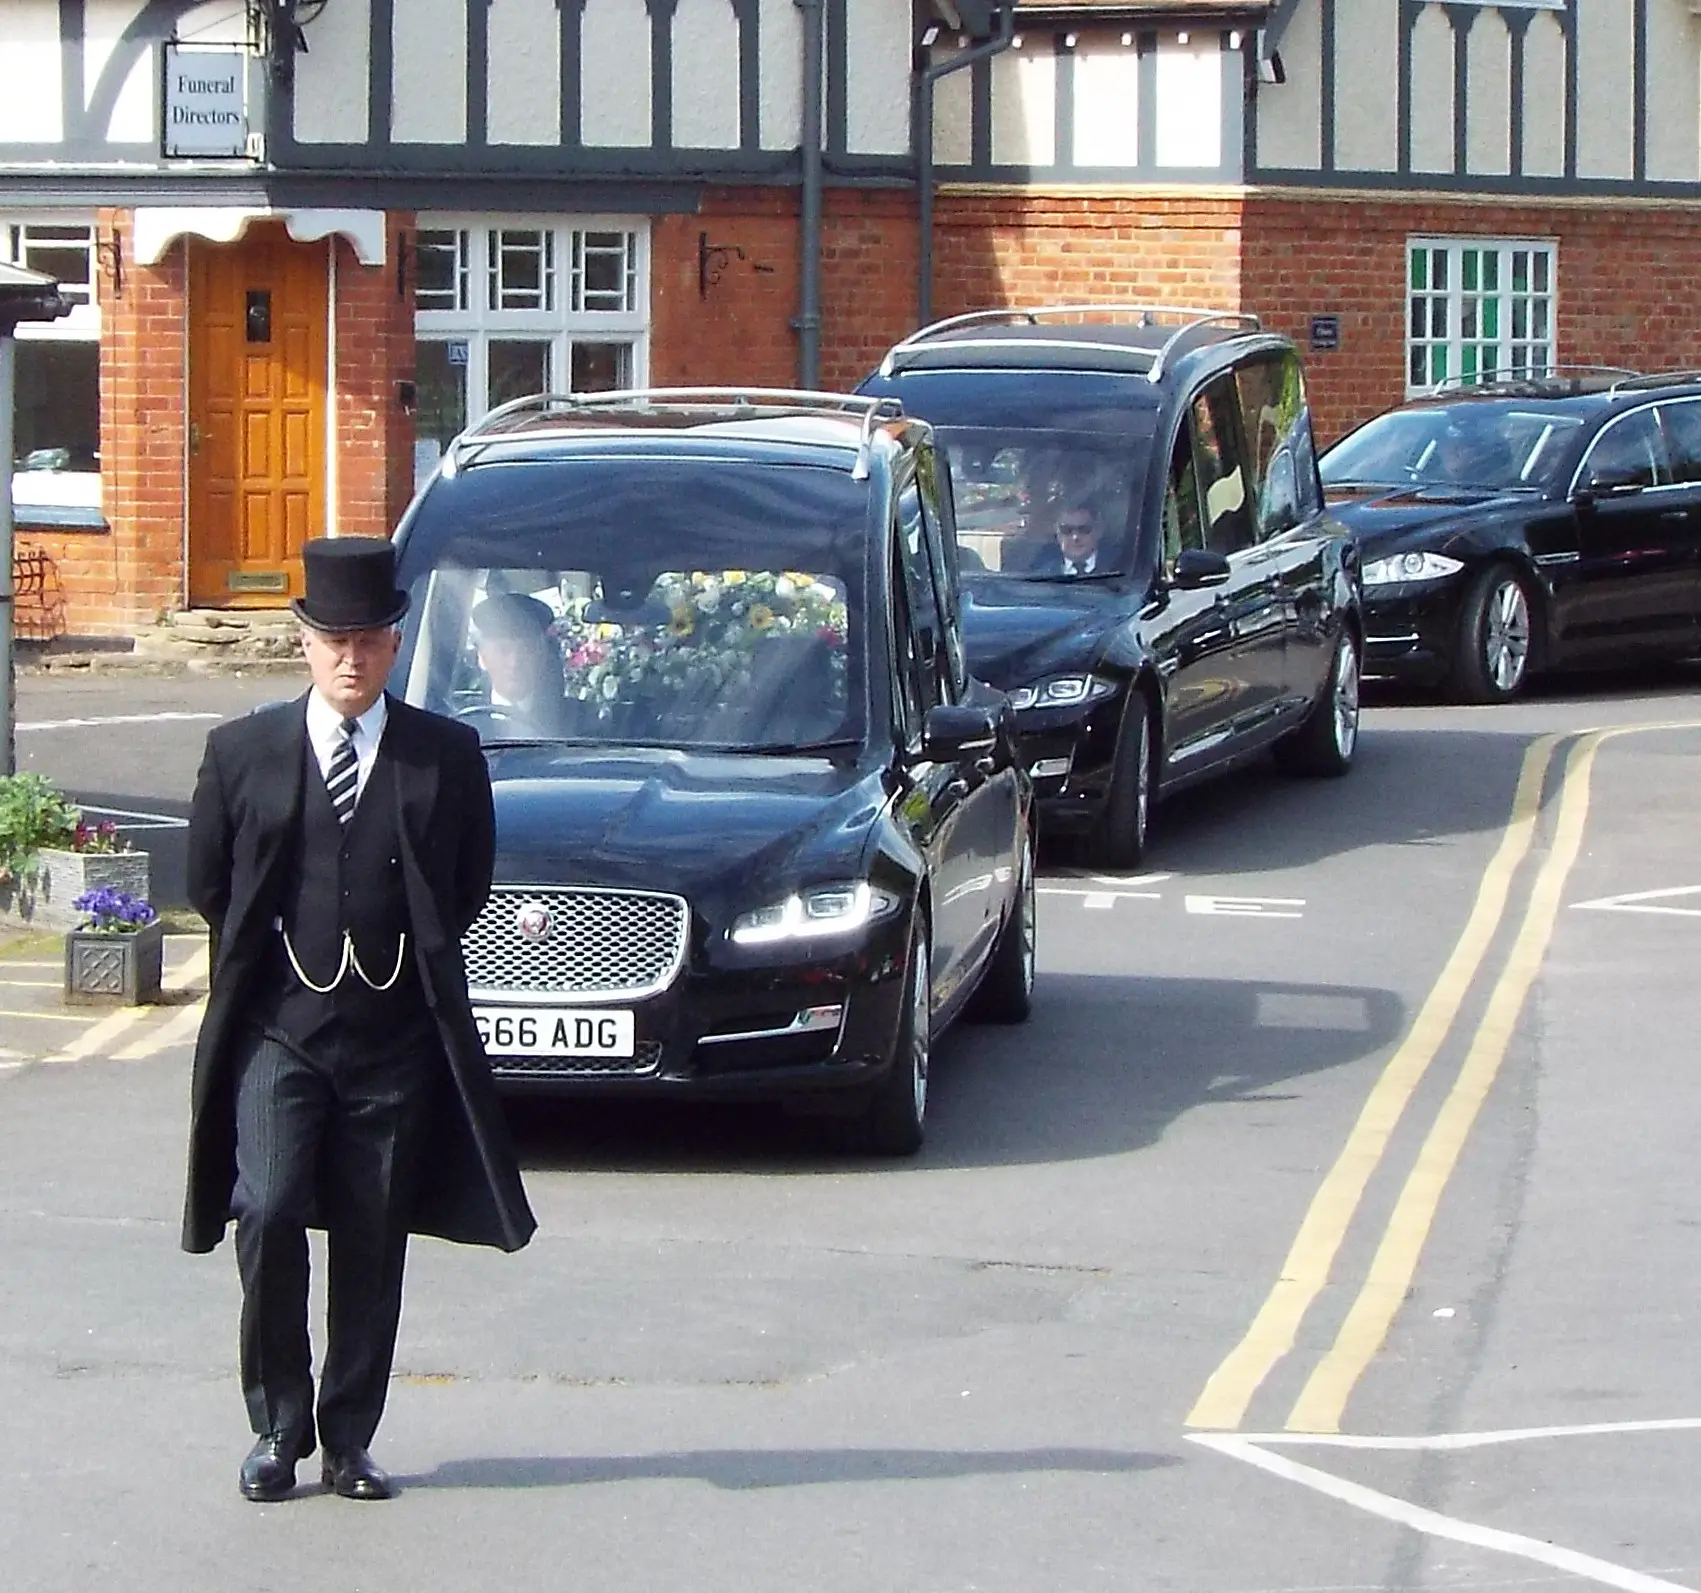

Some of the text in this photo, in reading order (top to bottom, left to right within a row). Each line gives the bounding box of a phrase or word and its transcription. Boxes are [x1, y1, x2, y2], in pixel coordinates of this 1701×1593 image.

[178, 75, 234, 93] Funeral
[173, 105, 240, 124] Directors
[551, 1017, 617, 1049] ADG
